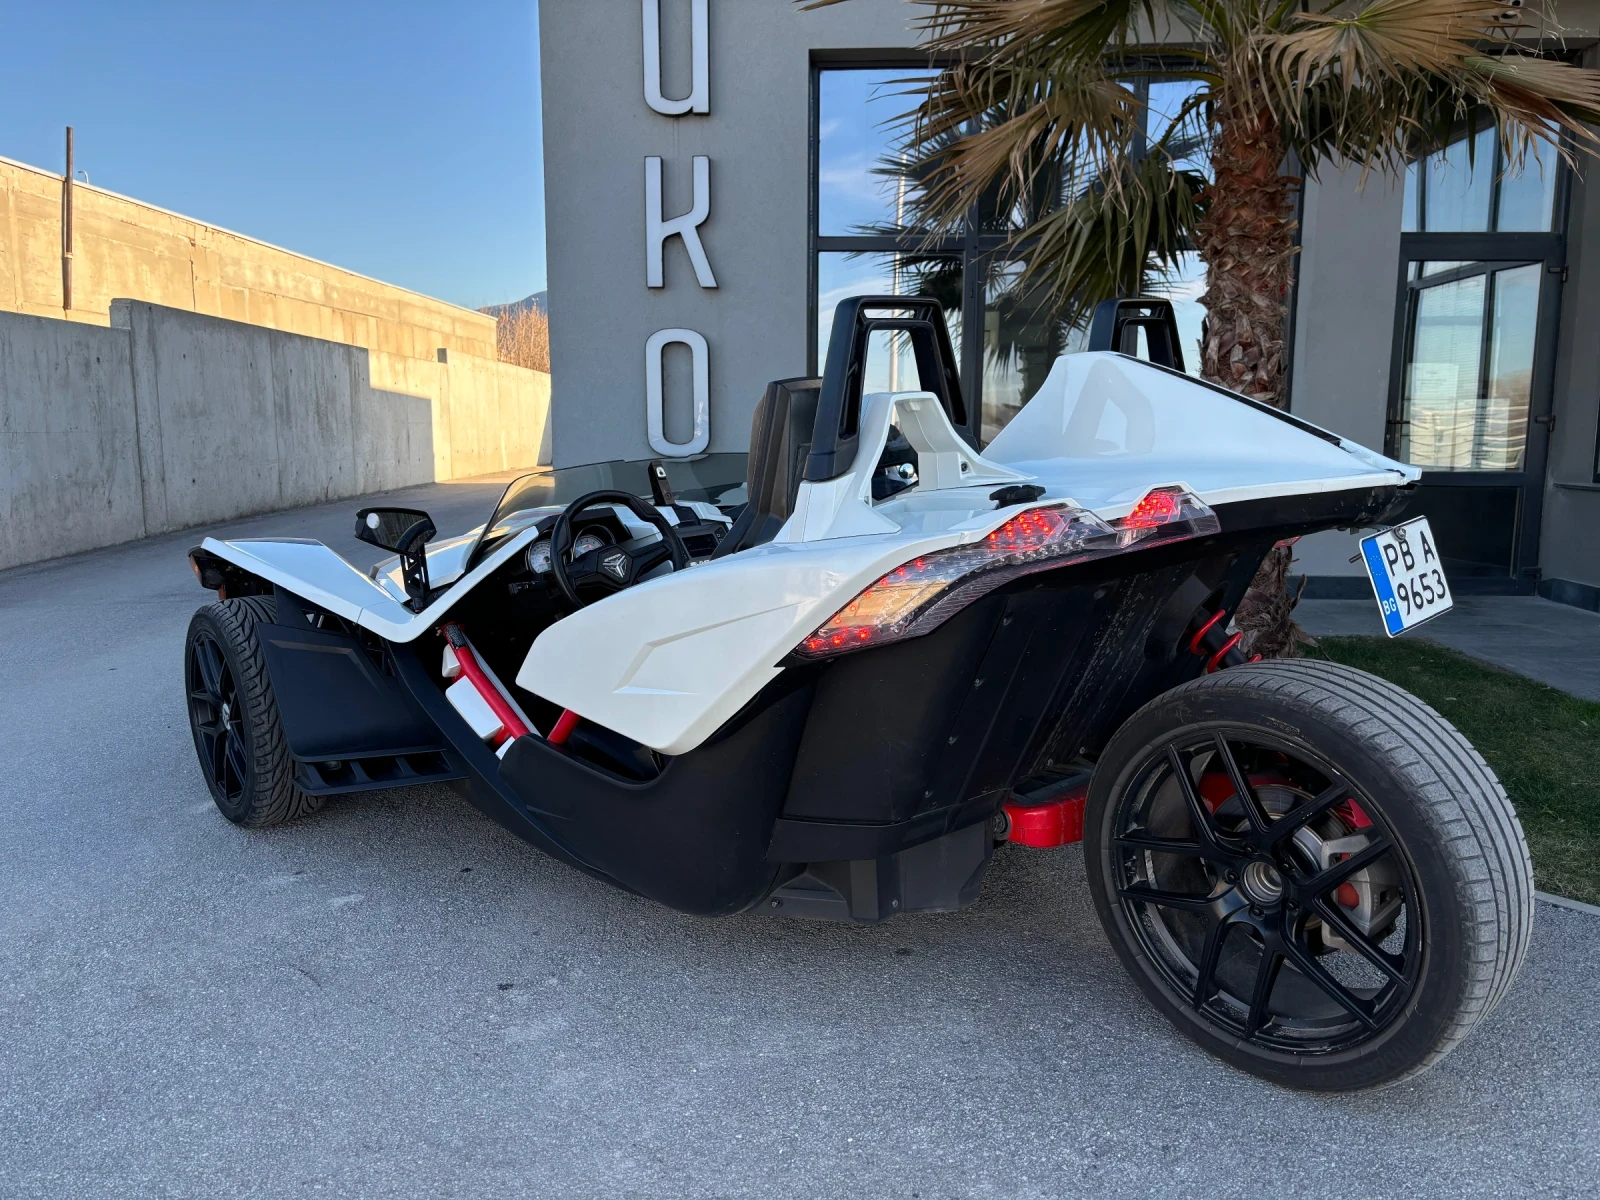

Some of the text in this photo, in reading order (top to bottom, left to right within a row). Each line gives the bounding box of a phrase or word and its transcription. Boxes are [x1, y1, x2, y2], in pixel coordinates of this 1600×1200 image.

[1383, 530, 1435, 577] PB A
[1382, 597, 1397, 615] BG
[1397, 569, 1446, 616] 9653
